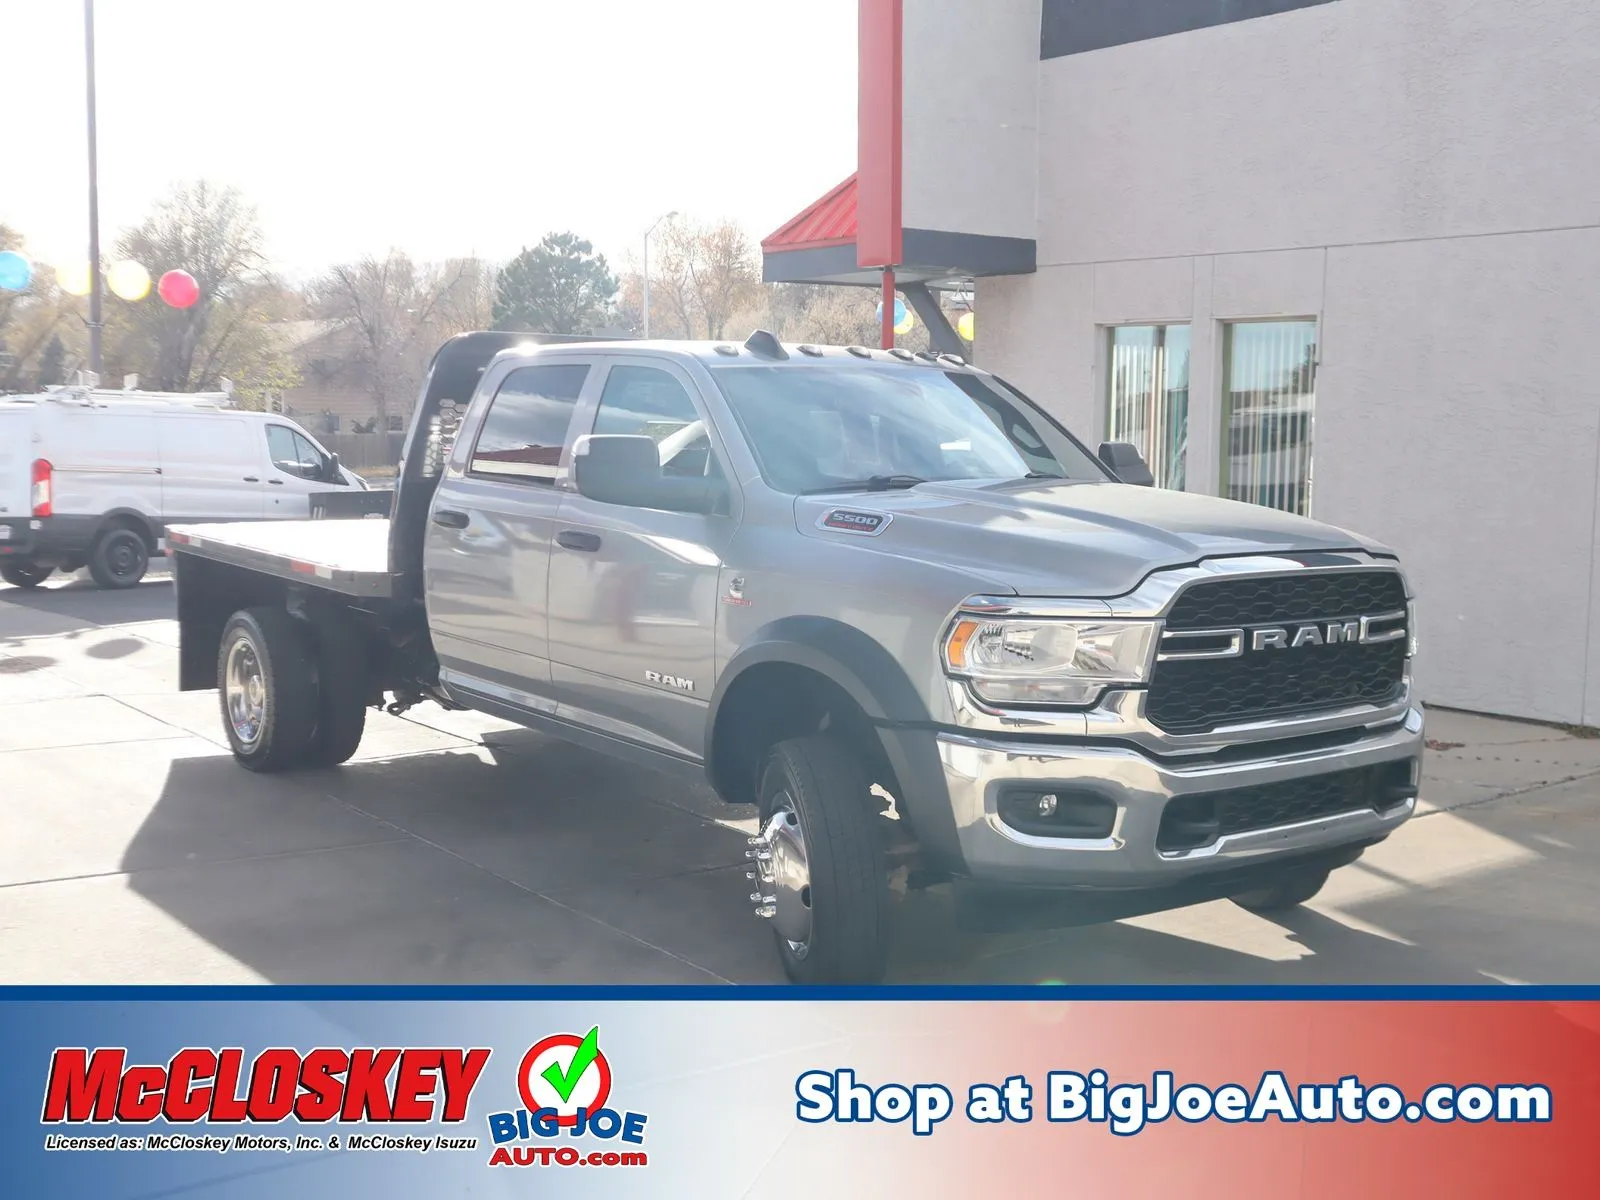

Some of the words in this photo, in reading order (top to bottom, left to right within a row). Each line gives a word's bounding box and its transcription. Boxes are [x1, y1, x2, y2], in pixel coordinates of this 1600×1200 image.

[832, 512, 879, 526] 5500
[1252, 620, 1360, 651] RAM
[645, 669, 696, 692] RAM
